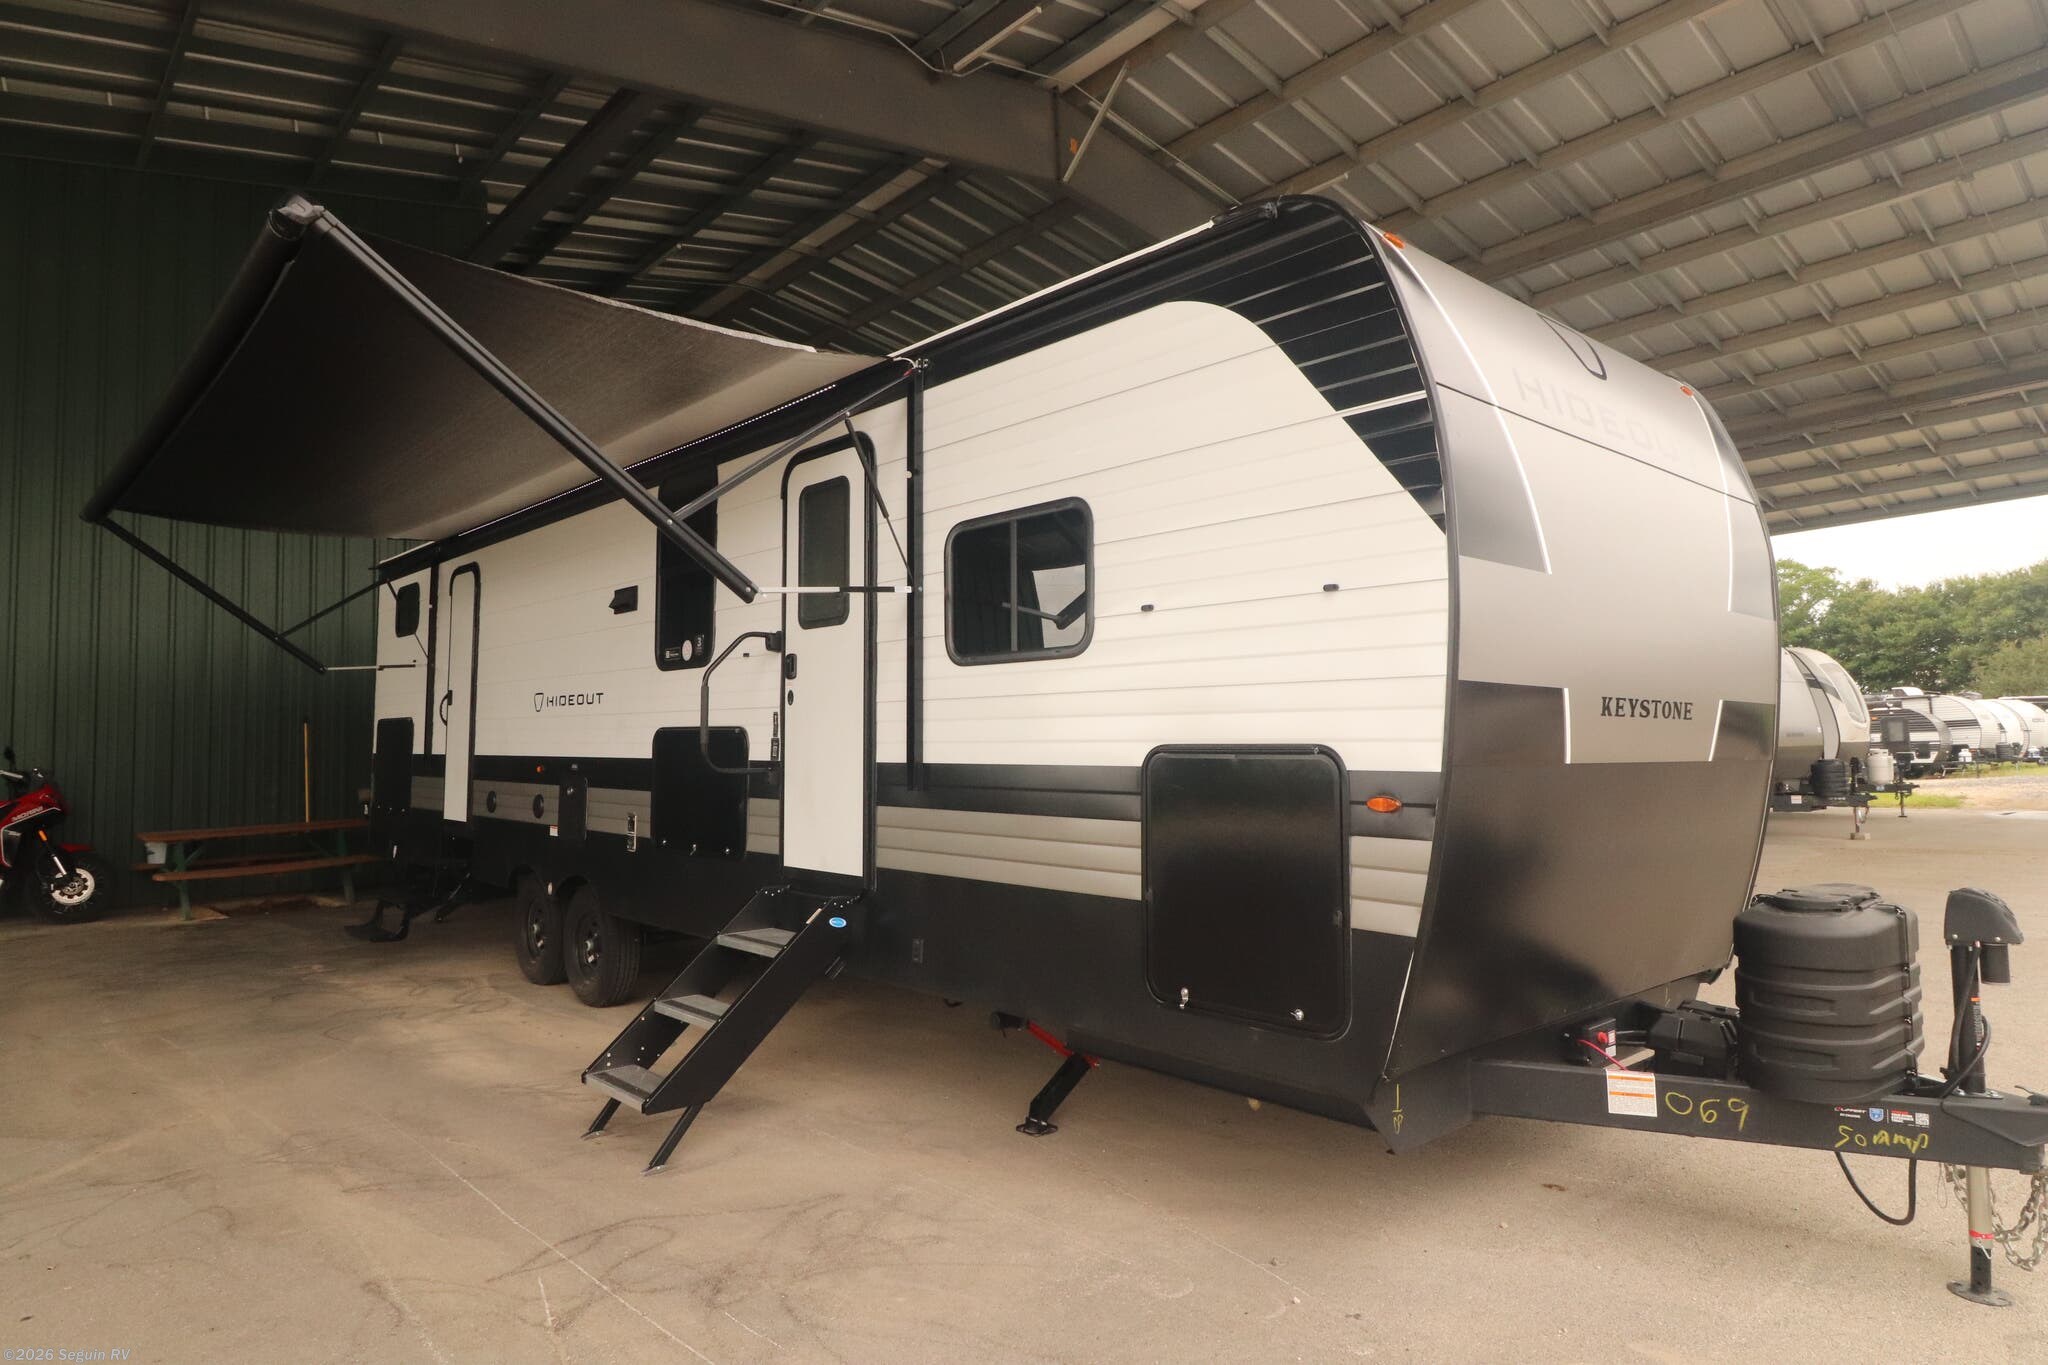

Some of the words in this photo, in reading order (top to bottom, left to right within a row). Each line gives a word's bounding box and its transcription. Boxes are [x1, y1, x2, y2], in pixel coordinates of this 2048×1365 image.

[546, 692, 604, 708] HIDEOUT
[1600, 696, 1694, 721] KEYSTONE
[1665, 1091, 1750, 1132] 069
